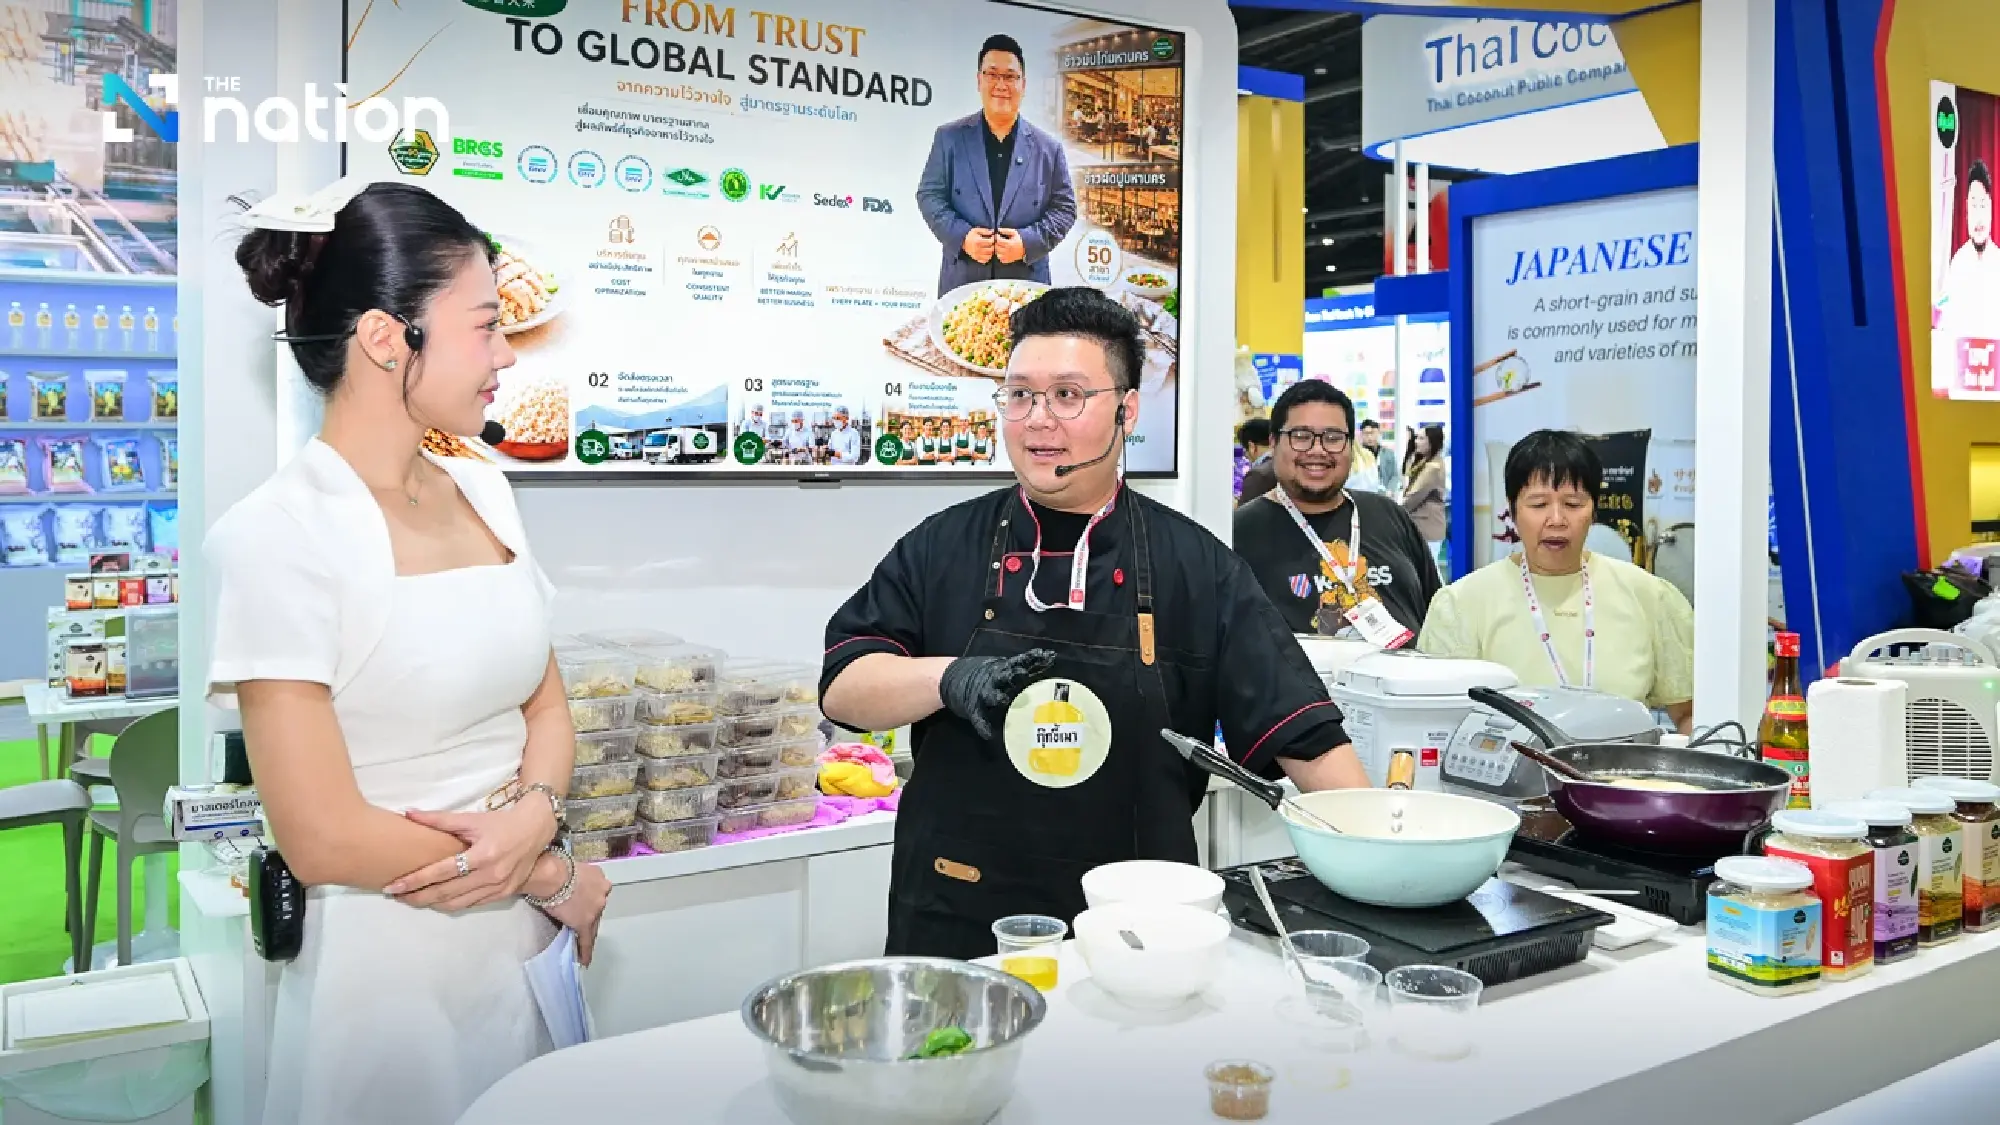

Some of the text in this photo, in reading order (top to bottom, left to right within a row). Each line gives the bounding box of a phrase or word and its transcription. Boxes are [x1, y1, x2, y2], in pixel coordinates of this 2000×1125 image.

[621, 0, 867, 57] FROM TRUST
[506, 17, 933, 107] TO GLOBAL STANDARD
[1425, 25, 1518, 83] Thai
[617, 80, 858, 123] จากความไว้วางใจ สู่มาตรฐานระดับโลก
[1427, 97, 1452, 113] Thai
[1457, 84, 1514, 108] Coconut
[1517, 74, 1563, 96] Public
[813, 193, 849, 208] Sedex
[863, 196, 894, 214] FDA
[1087, 245, 1112, 265] 50
[1506, 231, 1693, 285] JAPANESE
[1534, 297, 1546, 313] A
[1549, 288, 1639, 312] short-grain
[1643, 286, 1676, 304] and
[1507, 325, 1519, 340] is
[1522, 319, 1604, 341] commonly
[1608, 315, 1648, 334] used
[1652, 313, 1678, 332] for
[1554, 345, 1586, 363] and
[1588, 342, 1655, 360] varieties
[1659, 339, 1680, 357] of
[588, 372, 609, 388] 02
[744, 377, 763, 392] 03
[884, 382, 903, 397] 04
